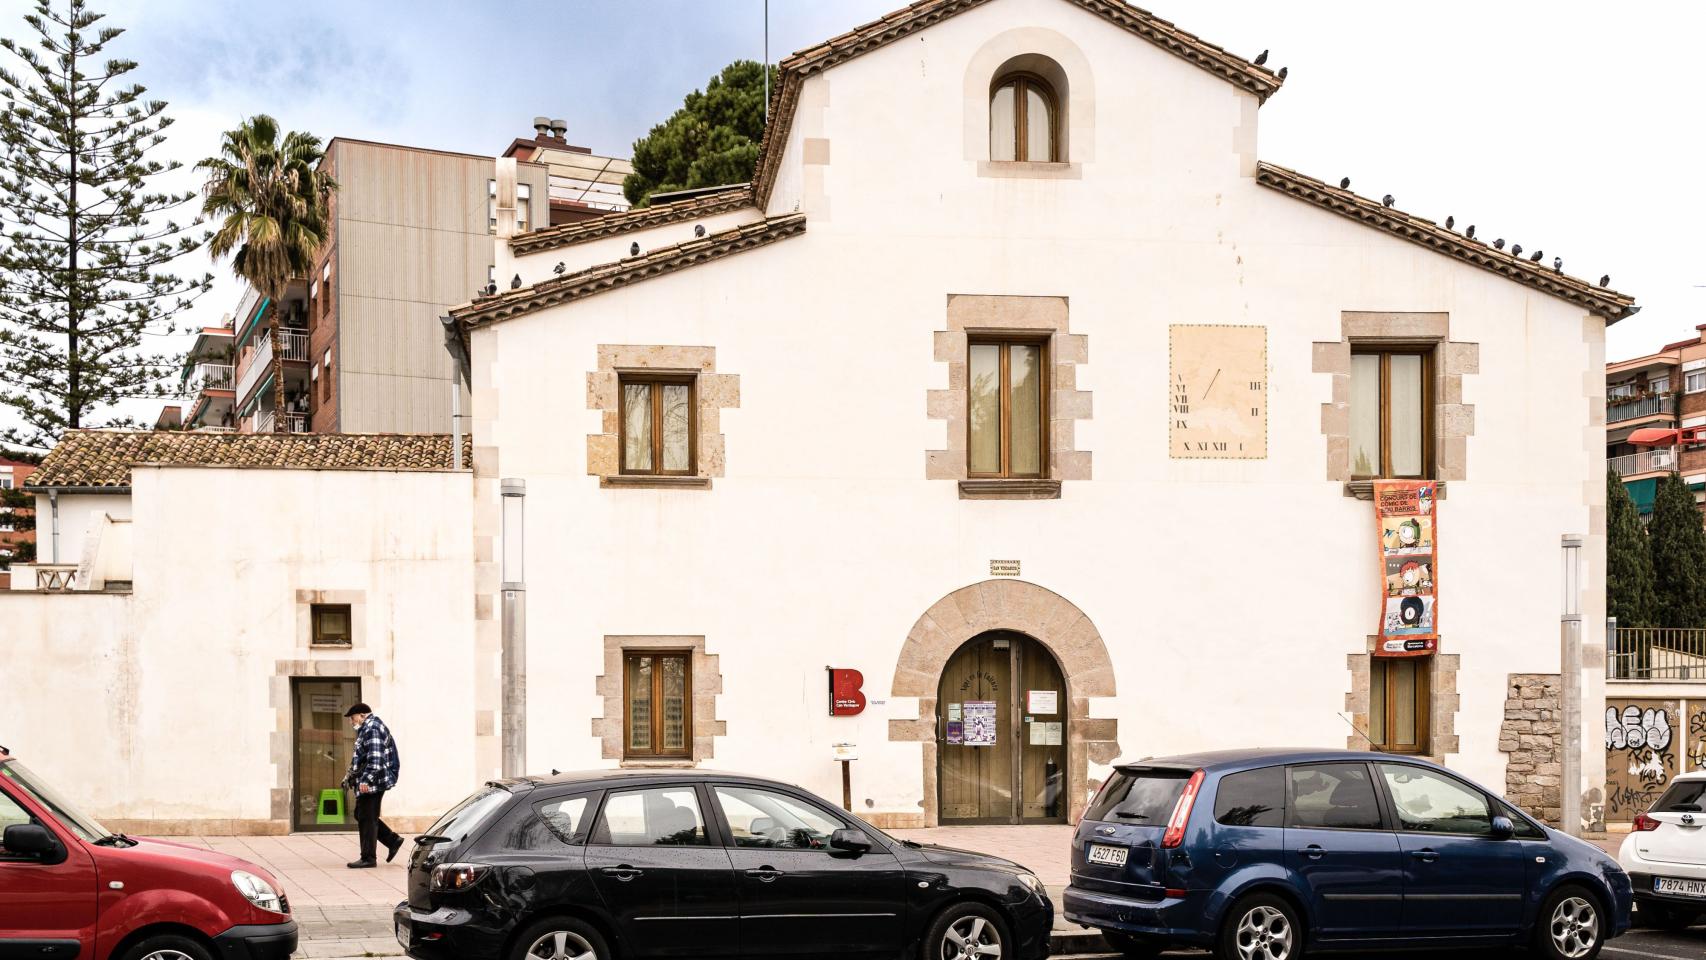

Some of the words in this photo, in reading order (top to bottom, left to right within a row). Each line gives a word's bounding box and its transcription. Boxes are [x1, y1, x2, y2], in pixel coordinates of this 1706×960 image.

[1176, 384, 1186, 392] VI
[1175, 395, 1188, 403] VII
[1174, 405, 1189, 413] VIII
[1251, 408, 1258, 416] II
[1176, 420, 1187, 428] IX
[1184, 442, 1190, 451] X
[1198, 442, 1207, 451] XI
[1213, 442, 1227, 451] XII
[1093, 848, 1110, 860] 4527
[1111, 850, 1126, 862] FSD
[1661, 880, 1684, 891] 7874
[1687, 881, 1706, 894] HNX
